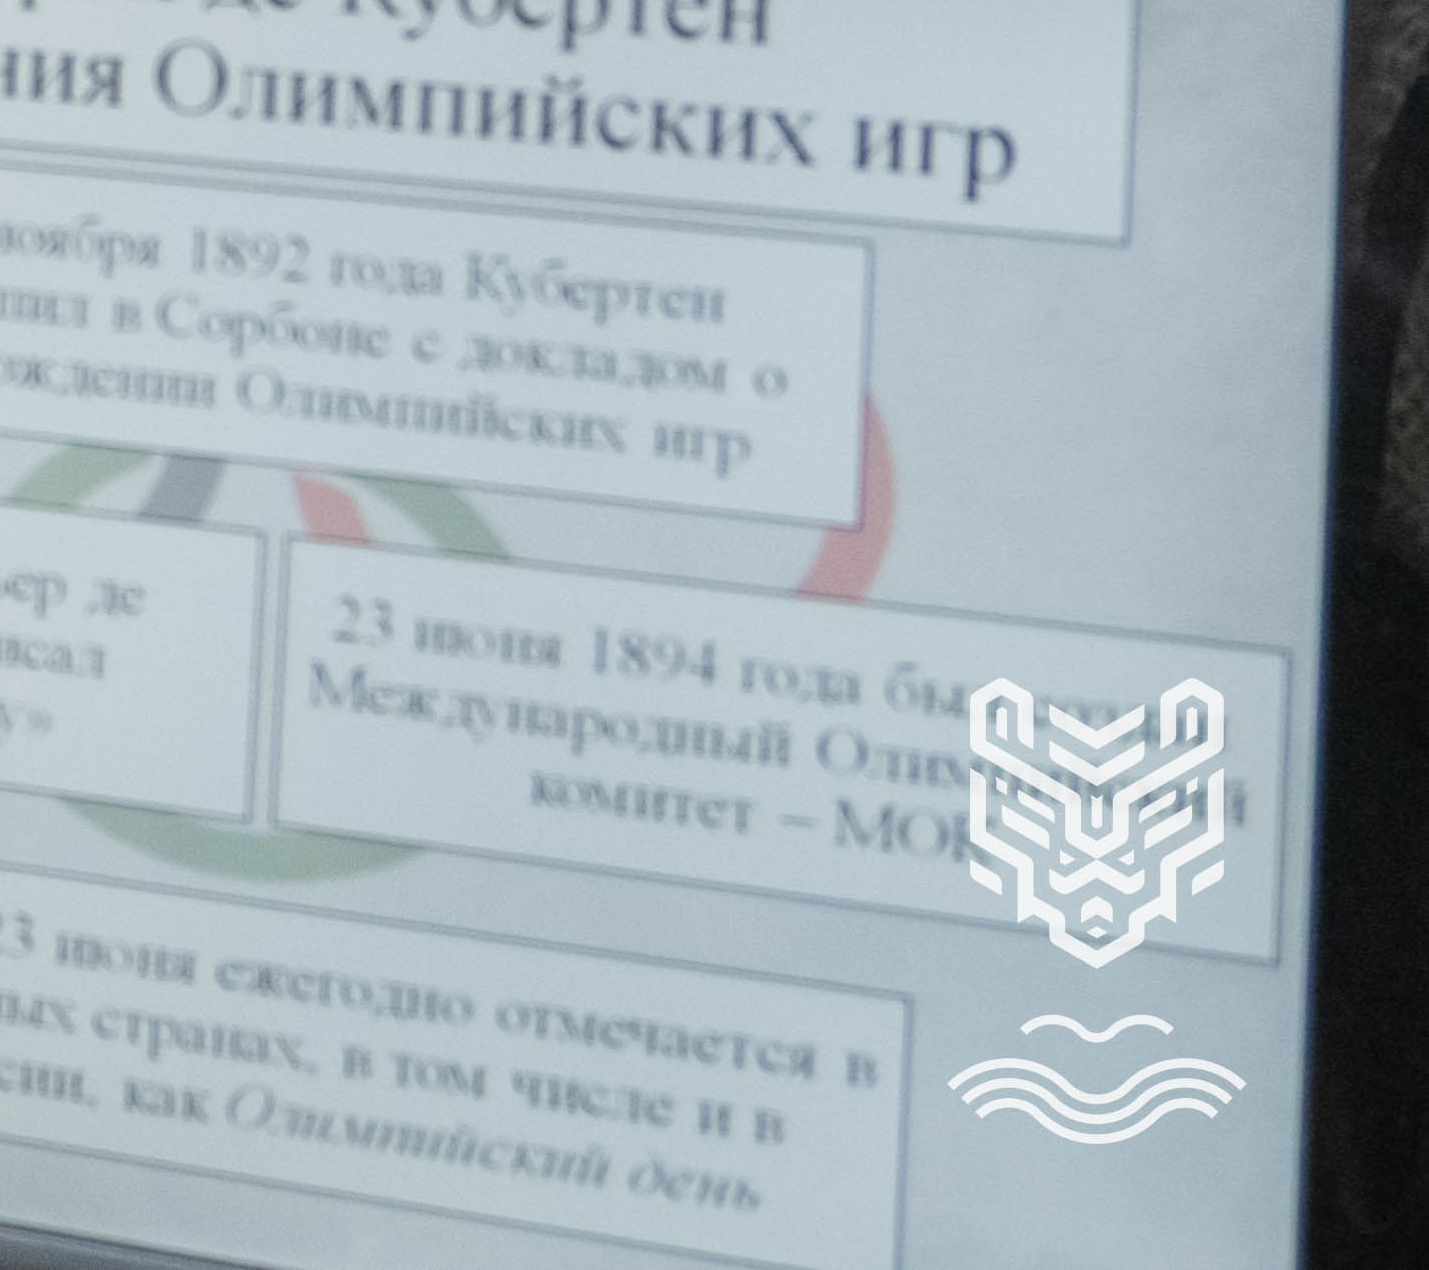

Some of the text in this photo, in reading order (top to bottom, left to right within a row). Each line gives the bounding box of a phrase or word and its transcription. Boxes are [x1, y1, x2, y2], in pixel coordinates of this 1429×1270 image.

[156, 40, 816, 169] Олимпийских
[848, 107, 1021, 202] игр
[186, 227, 311, 285] 1892
[327, 249, 445, 303] года
[462, 252, 728, 328] Кубертен
[113, 299, 142, 331] в
[153, 297, 392, 362] Сорбоне
[411, 330, 440, 362] с
[458, 334, 731, 399] докладом
[751, 364, 789, 401] о
[233, 373, 628, 457] Олимпийских
[651, 424, 753, 477] игр
[84, 579, 147, 619] де
[328, 593, 394, 645] 23
[413, 614, 563, 672] июня
[587, 624, 717, 686] 1894
[737, 655, 863, 709] года
[883, 660, 1004, 722] бы
[307, 660, 791, 772] Международный
[528, 771, 755, 836] комитет
[54, 930, 199, 991] июня
[212, 956, 475, 1031] ежегодно
[494, 997, 817, 1083] отмечается
[844, 1046, 880, 1086] в
[89, 1004, 314, 1075] странах,
[340, 1041, 374, 1082] в
[393, 1050, 489, 1101] том
[509, 1068, 674, 1129] числе
[696, 1096, 735, 1137] и
[753, 1106, 787, 1146] в
[122, 1077, 213, 1129] как
[225, 1084, 608, 1190] Олимпийский
[628, 1152, 763, 1218] день
